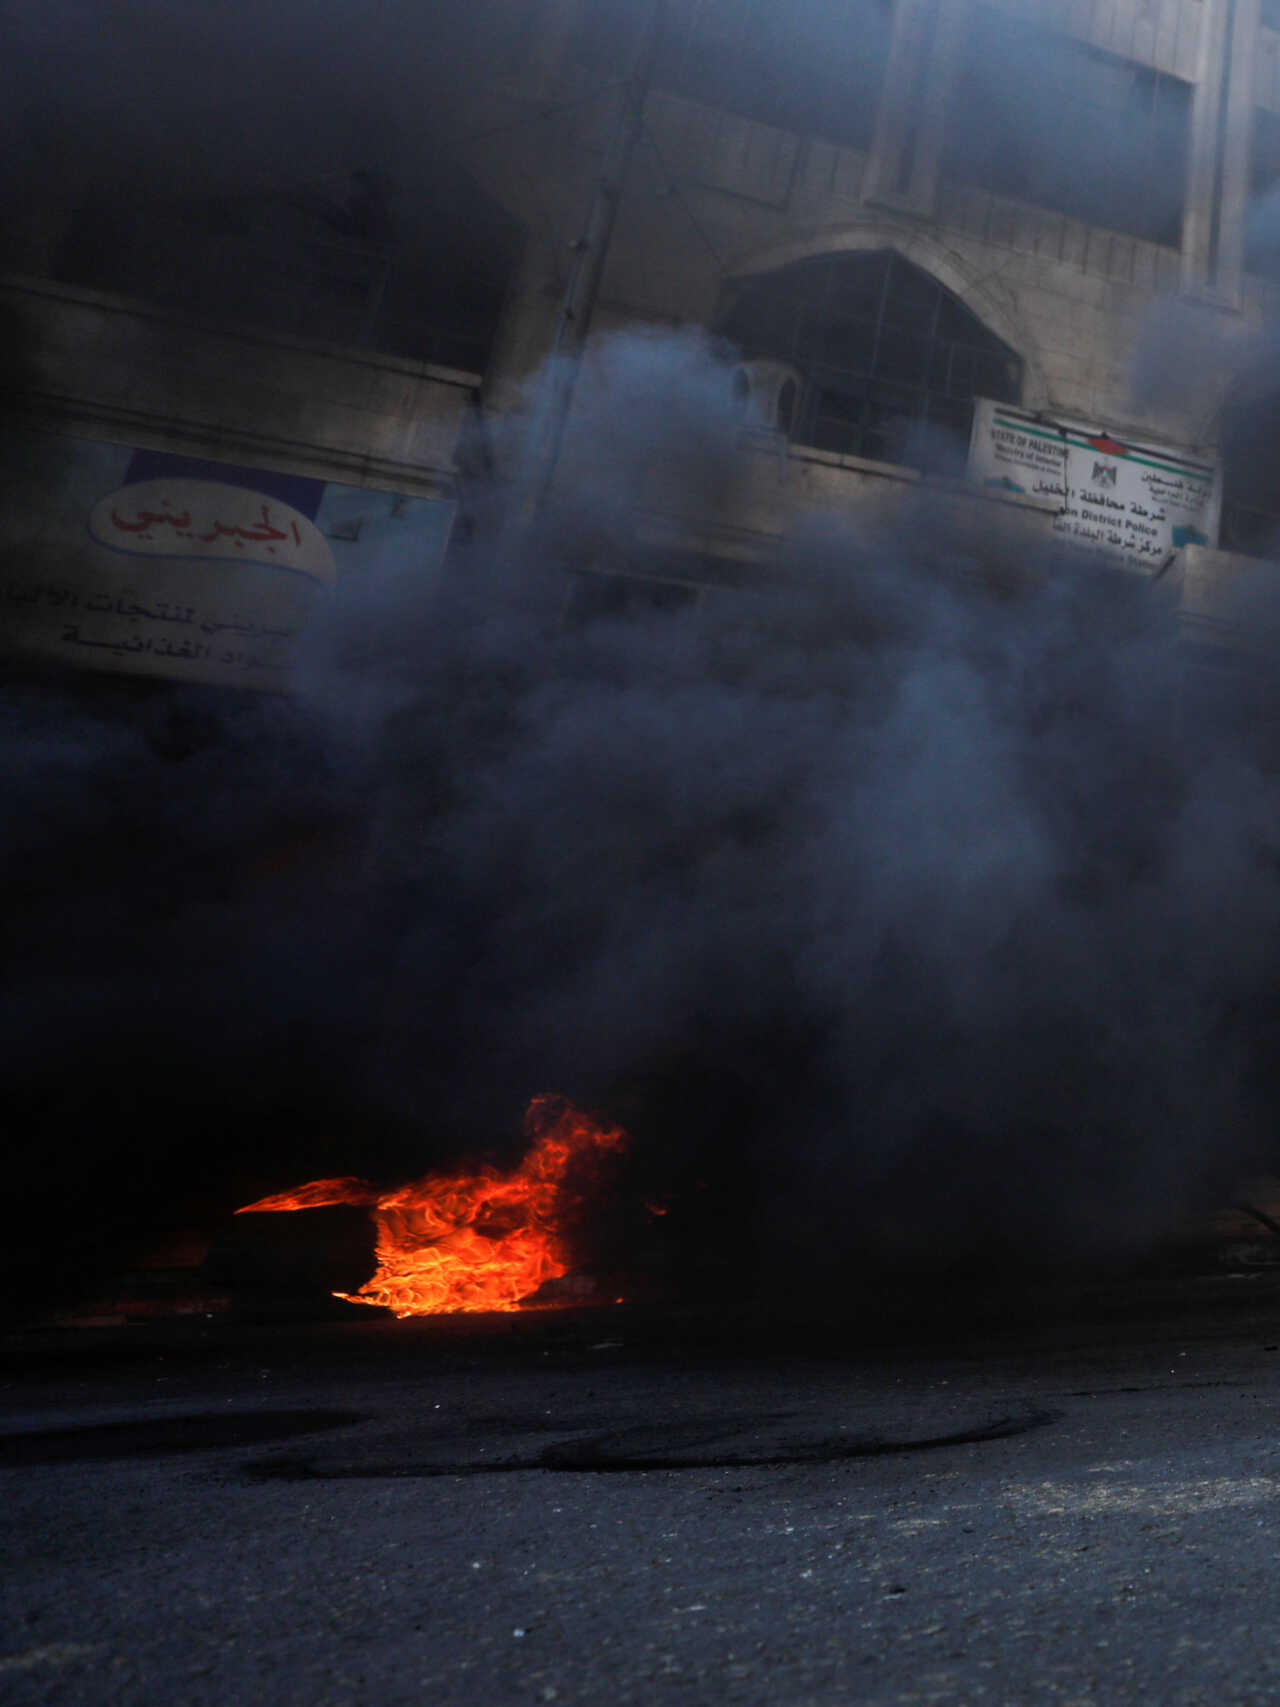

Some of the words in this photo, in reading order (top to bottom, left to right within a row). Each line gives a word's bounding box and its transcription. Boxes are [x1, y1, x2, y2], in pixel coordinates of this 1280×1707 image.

[991, 428, 1015, 445] STATE
[1016, 435, 1027, 447] OF
[1032, 480, 1075, 499] الخليل
[1141, 471, 1184, 489] فلسطين
[1079, 488, 1126, 511] محافظة
[1130, 501, 1167, 522] شرطة
[110, 498, 303, 554] الجبريني
[1082, 509, 1122, 528] District
[1125, 518, 1159, 537] Police
[1107, 530, 1136, 550] شرطة
[1139, 538, 1162, 556] مركز
